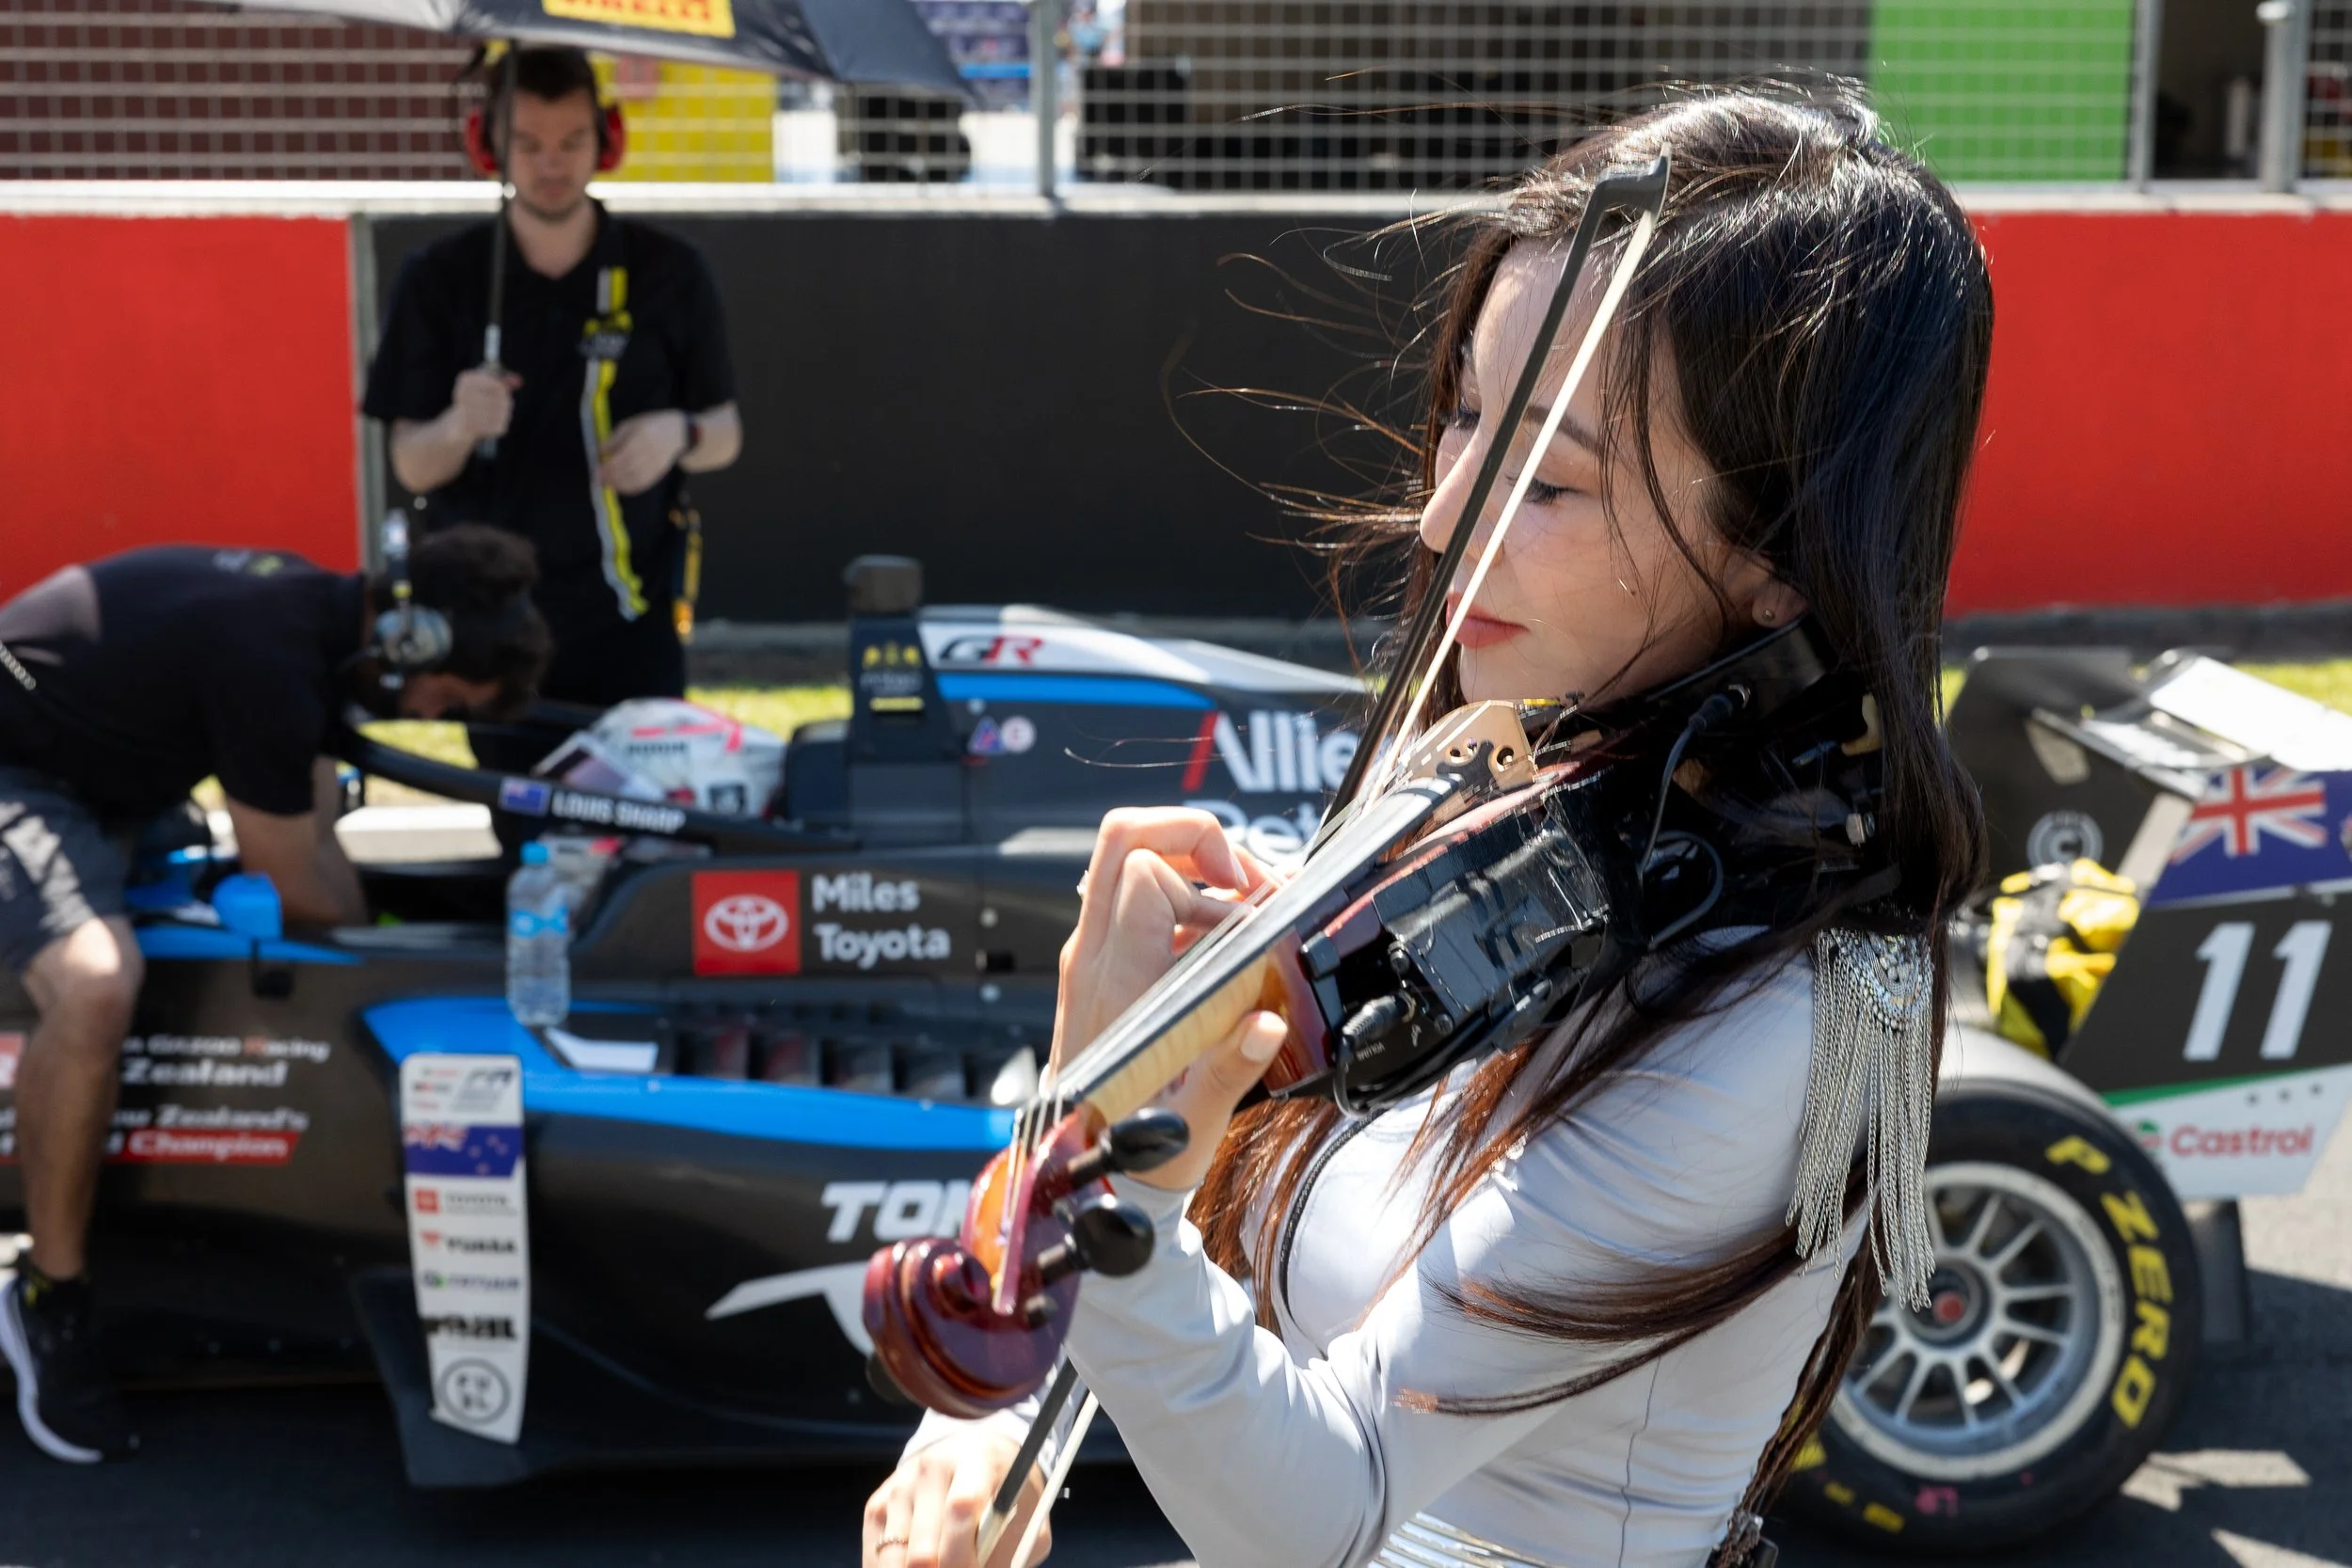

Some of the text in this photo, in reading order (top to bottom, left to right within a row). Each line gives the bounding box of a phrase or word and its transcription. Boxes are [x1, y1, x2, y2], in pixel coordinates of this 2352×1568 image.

[939, 635, 1046, 668] GR
[1182, 709, 1360, 793] Allie
[811, 871, 920, 913] Miles
[812, 922, 952, 970] Toyota
[2183, 921, 2333, 1062] 11
[123, 1059, 289, 1086] Zealand
[128, 1130, 289, 1161] Champion
[2169, 1122, 2316, 1158] Castrol
